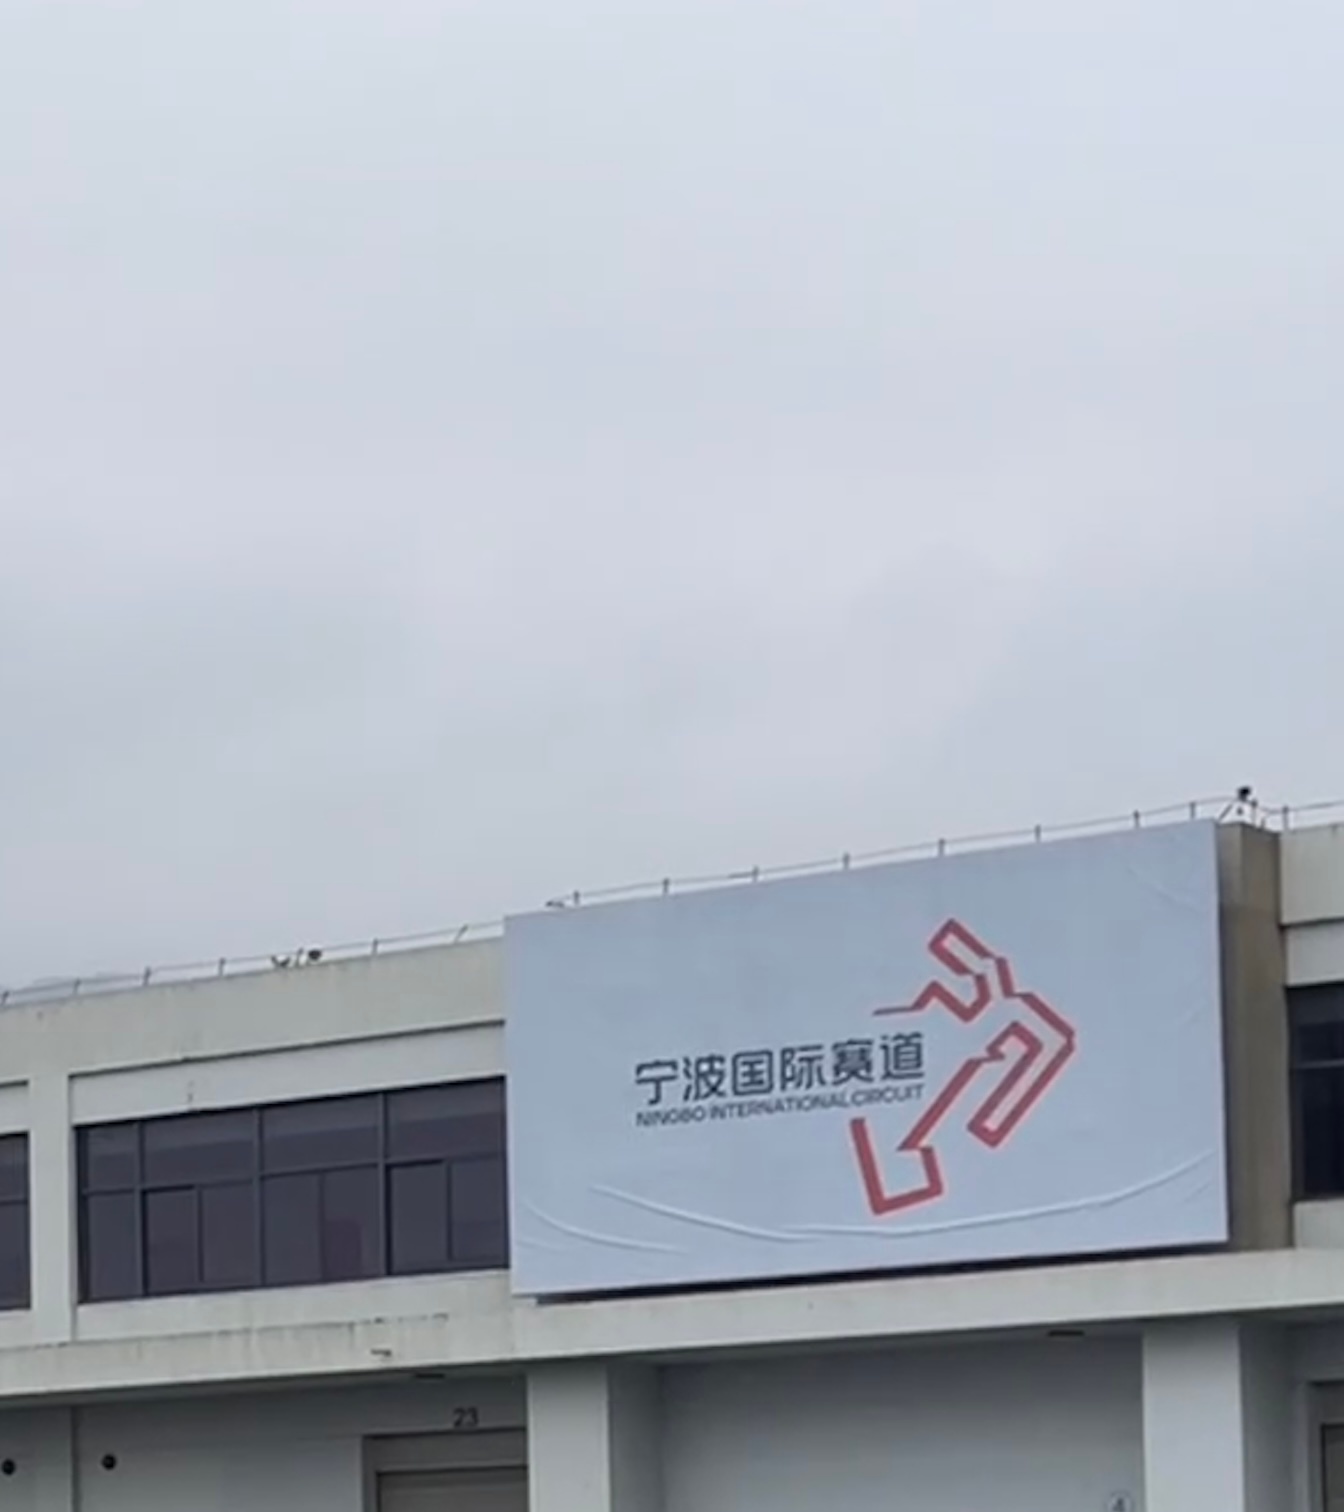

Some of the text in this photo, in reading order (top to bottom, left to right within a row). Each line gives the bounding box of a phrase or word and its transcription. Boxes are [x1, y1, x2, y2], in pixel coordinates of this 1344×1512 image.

[635, 1032, 924, 1105] 宁波国际赛道
[636, 1084, 924, 1127] NINGBO INTERNATIONAL CIRCUIT
[453, 1407, 479, 1427] 23
